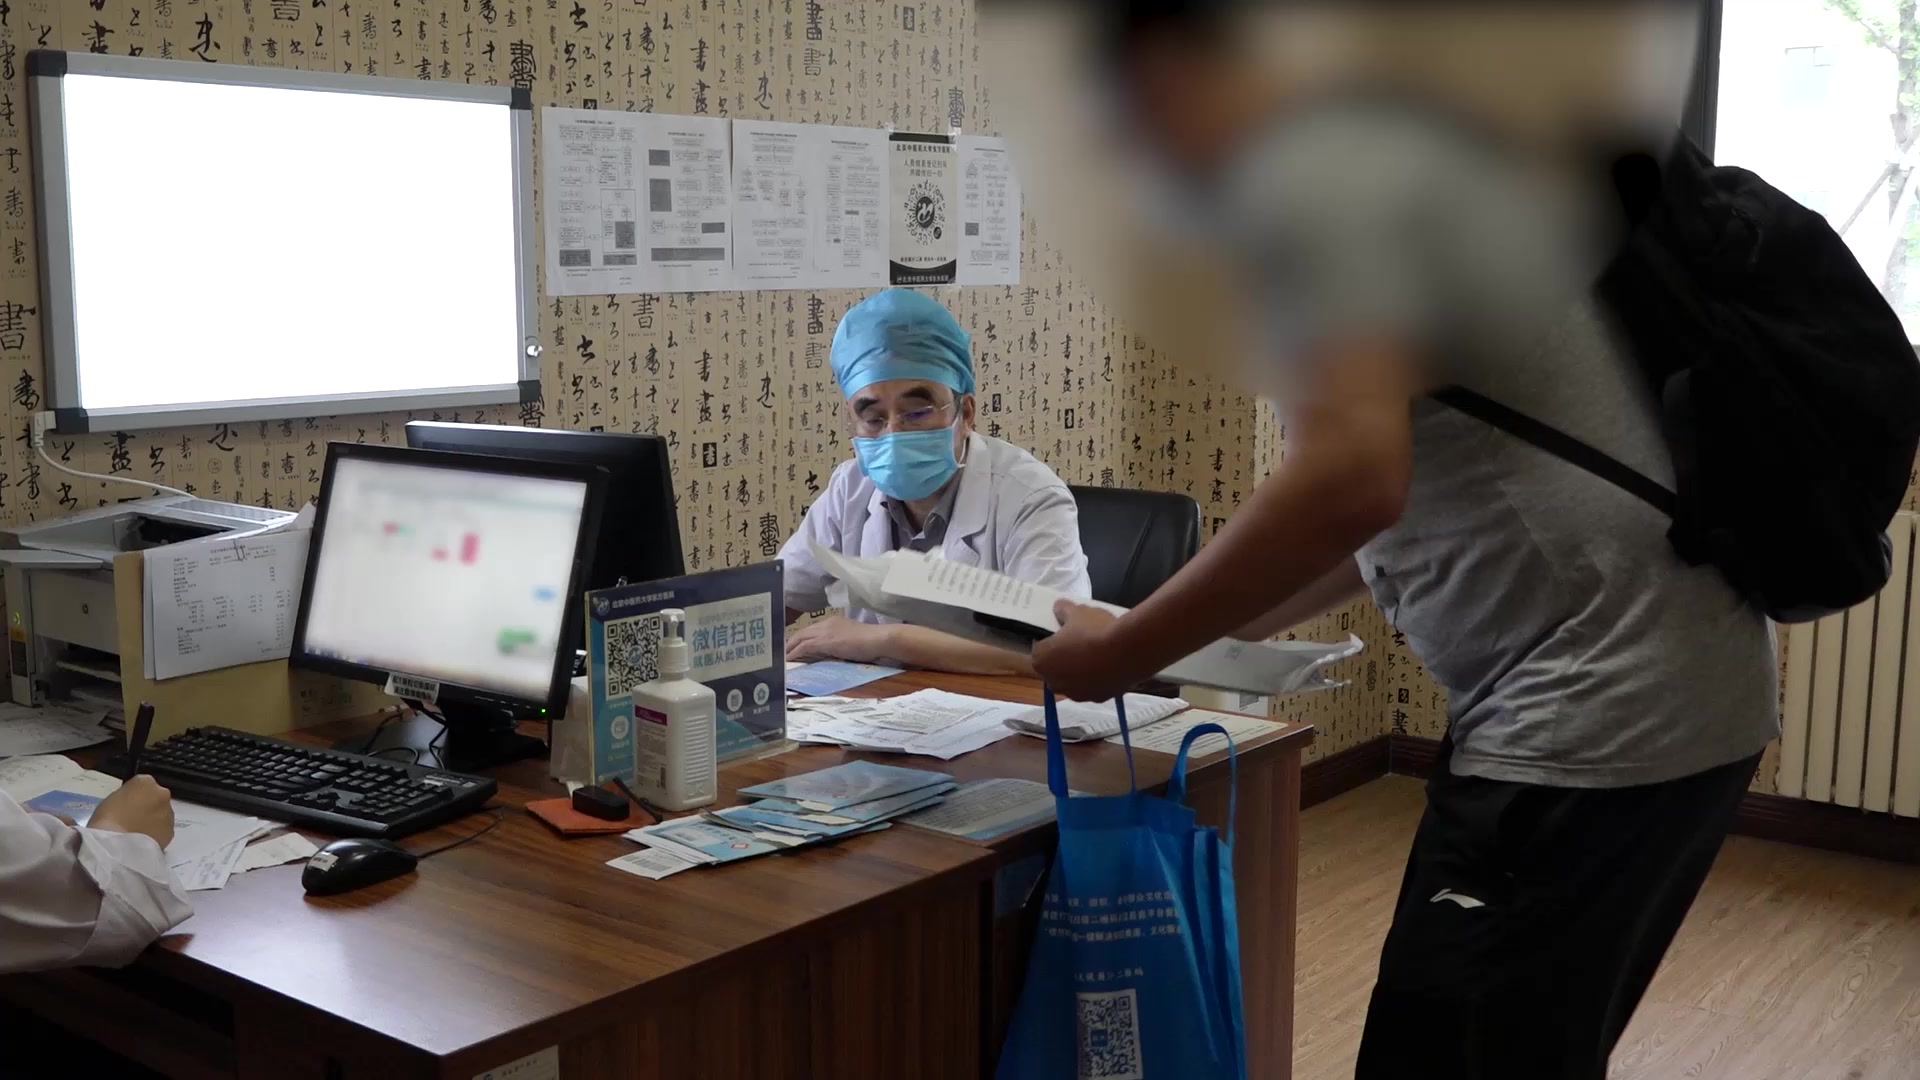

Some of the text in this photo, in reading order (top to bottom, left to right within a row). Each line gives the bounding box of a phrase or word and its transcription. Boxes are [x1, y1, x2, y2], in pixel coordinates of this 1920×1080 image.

[692, 617, 766, 652] 微信扫码
[693, 644, 766, 668] 就医从此更轻松
